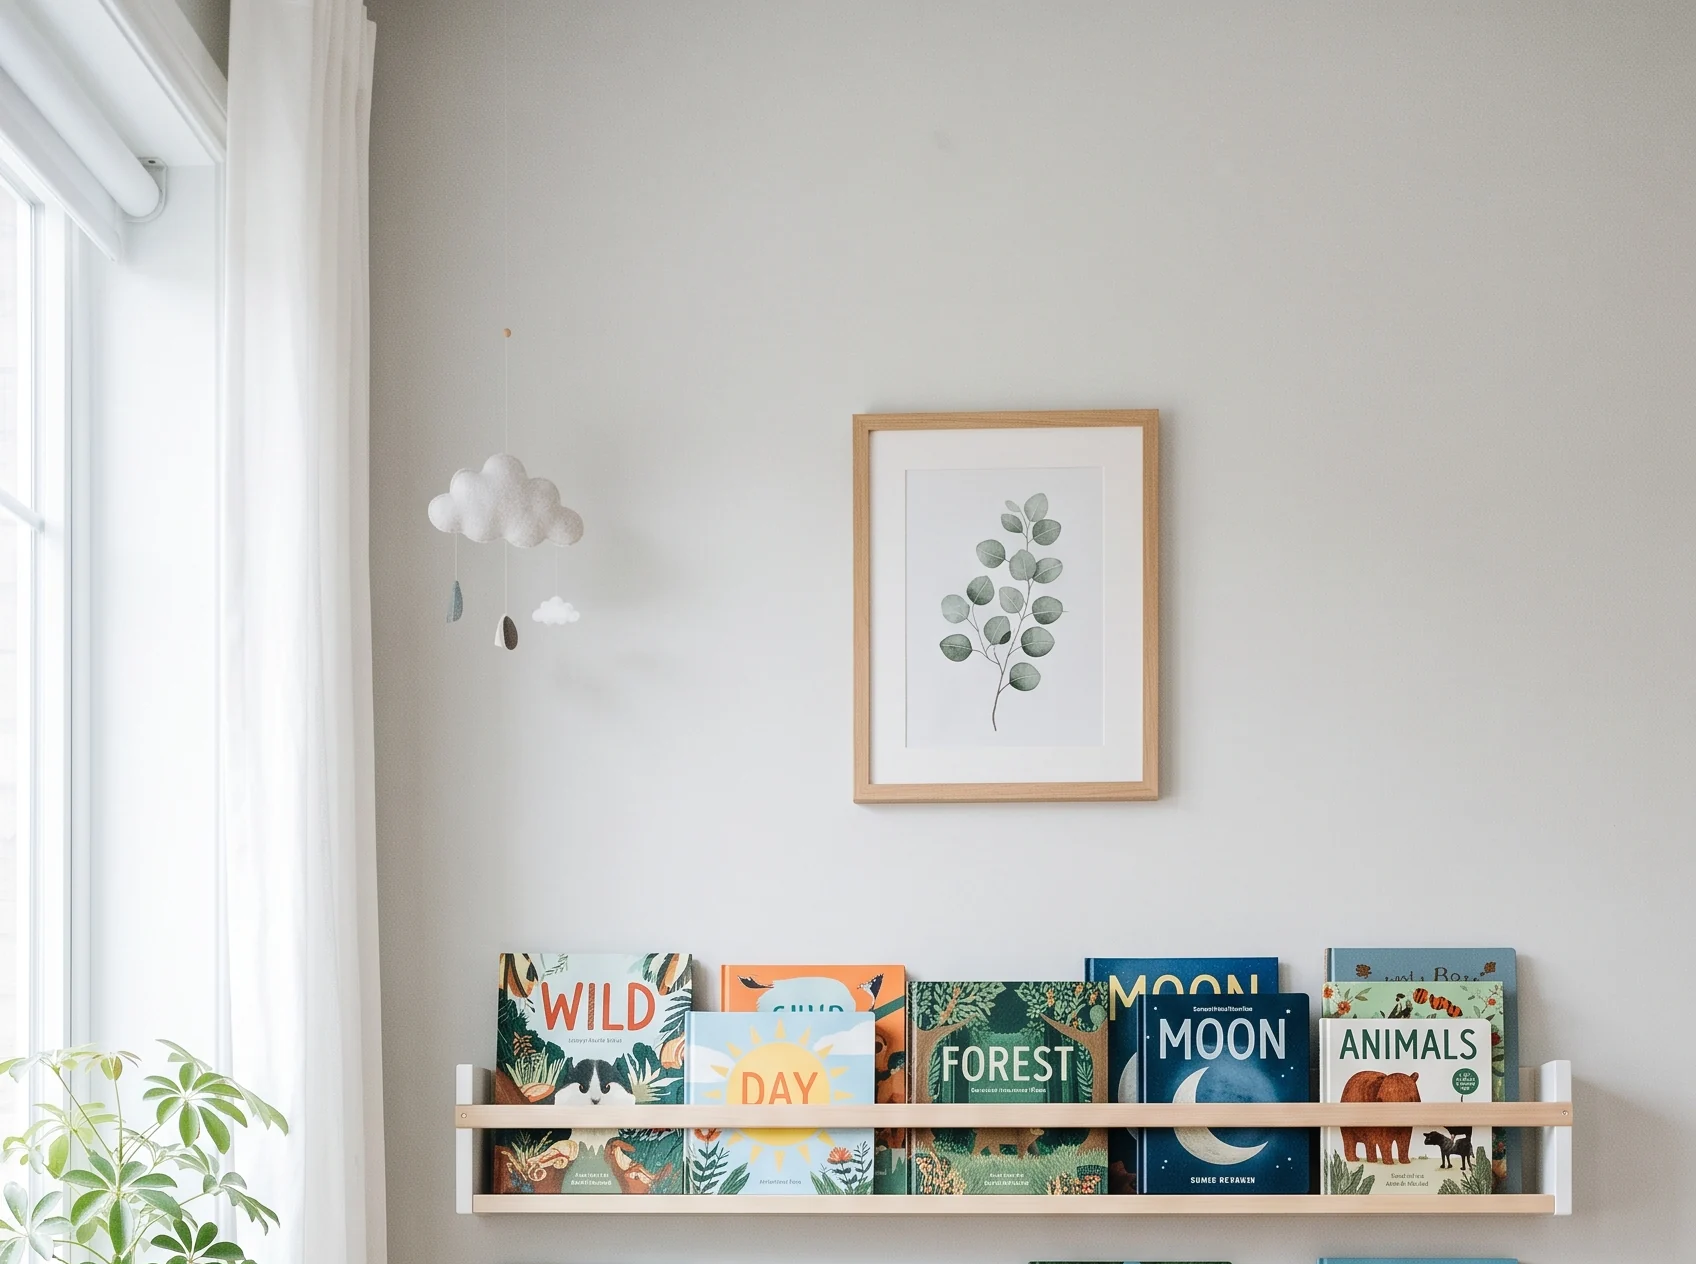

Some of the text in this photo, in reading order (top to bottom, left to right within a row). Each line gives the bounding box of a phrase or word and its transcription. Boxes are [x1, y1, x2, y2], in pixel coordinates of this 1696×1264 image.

[541, 981, 655, 1031] WILD
[1159, 1018, 1286, 1060] MOON
[1339, 1028, 1478, 1060] ANIMALS
[942, 1046, 1074, 1082] FOREST
[741, 1071, 819, 1104] DAY
